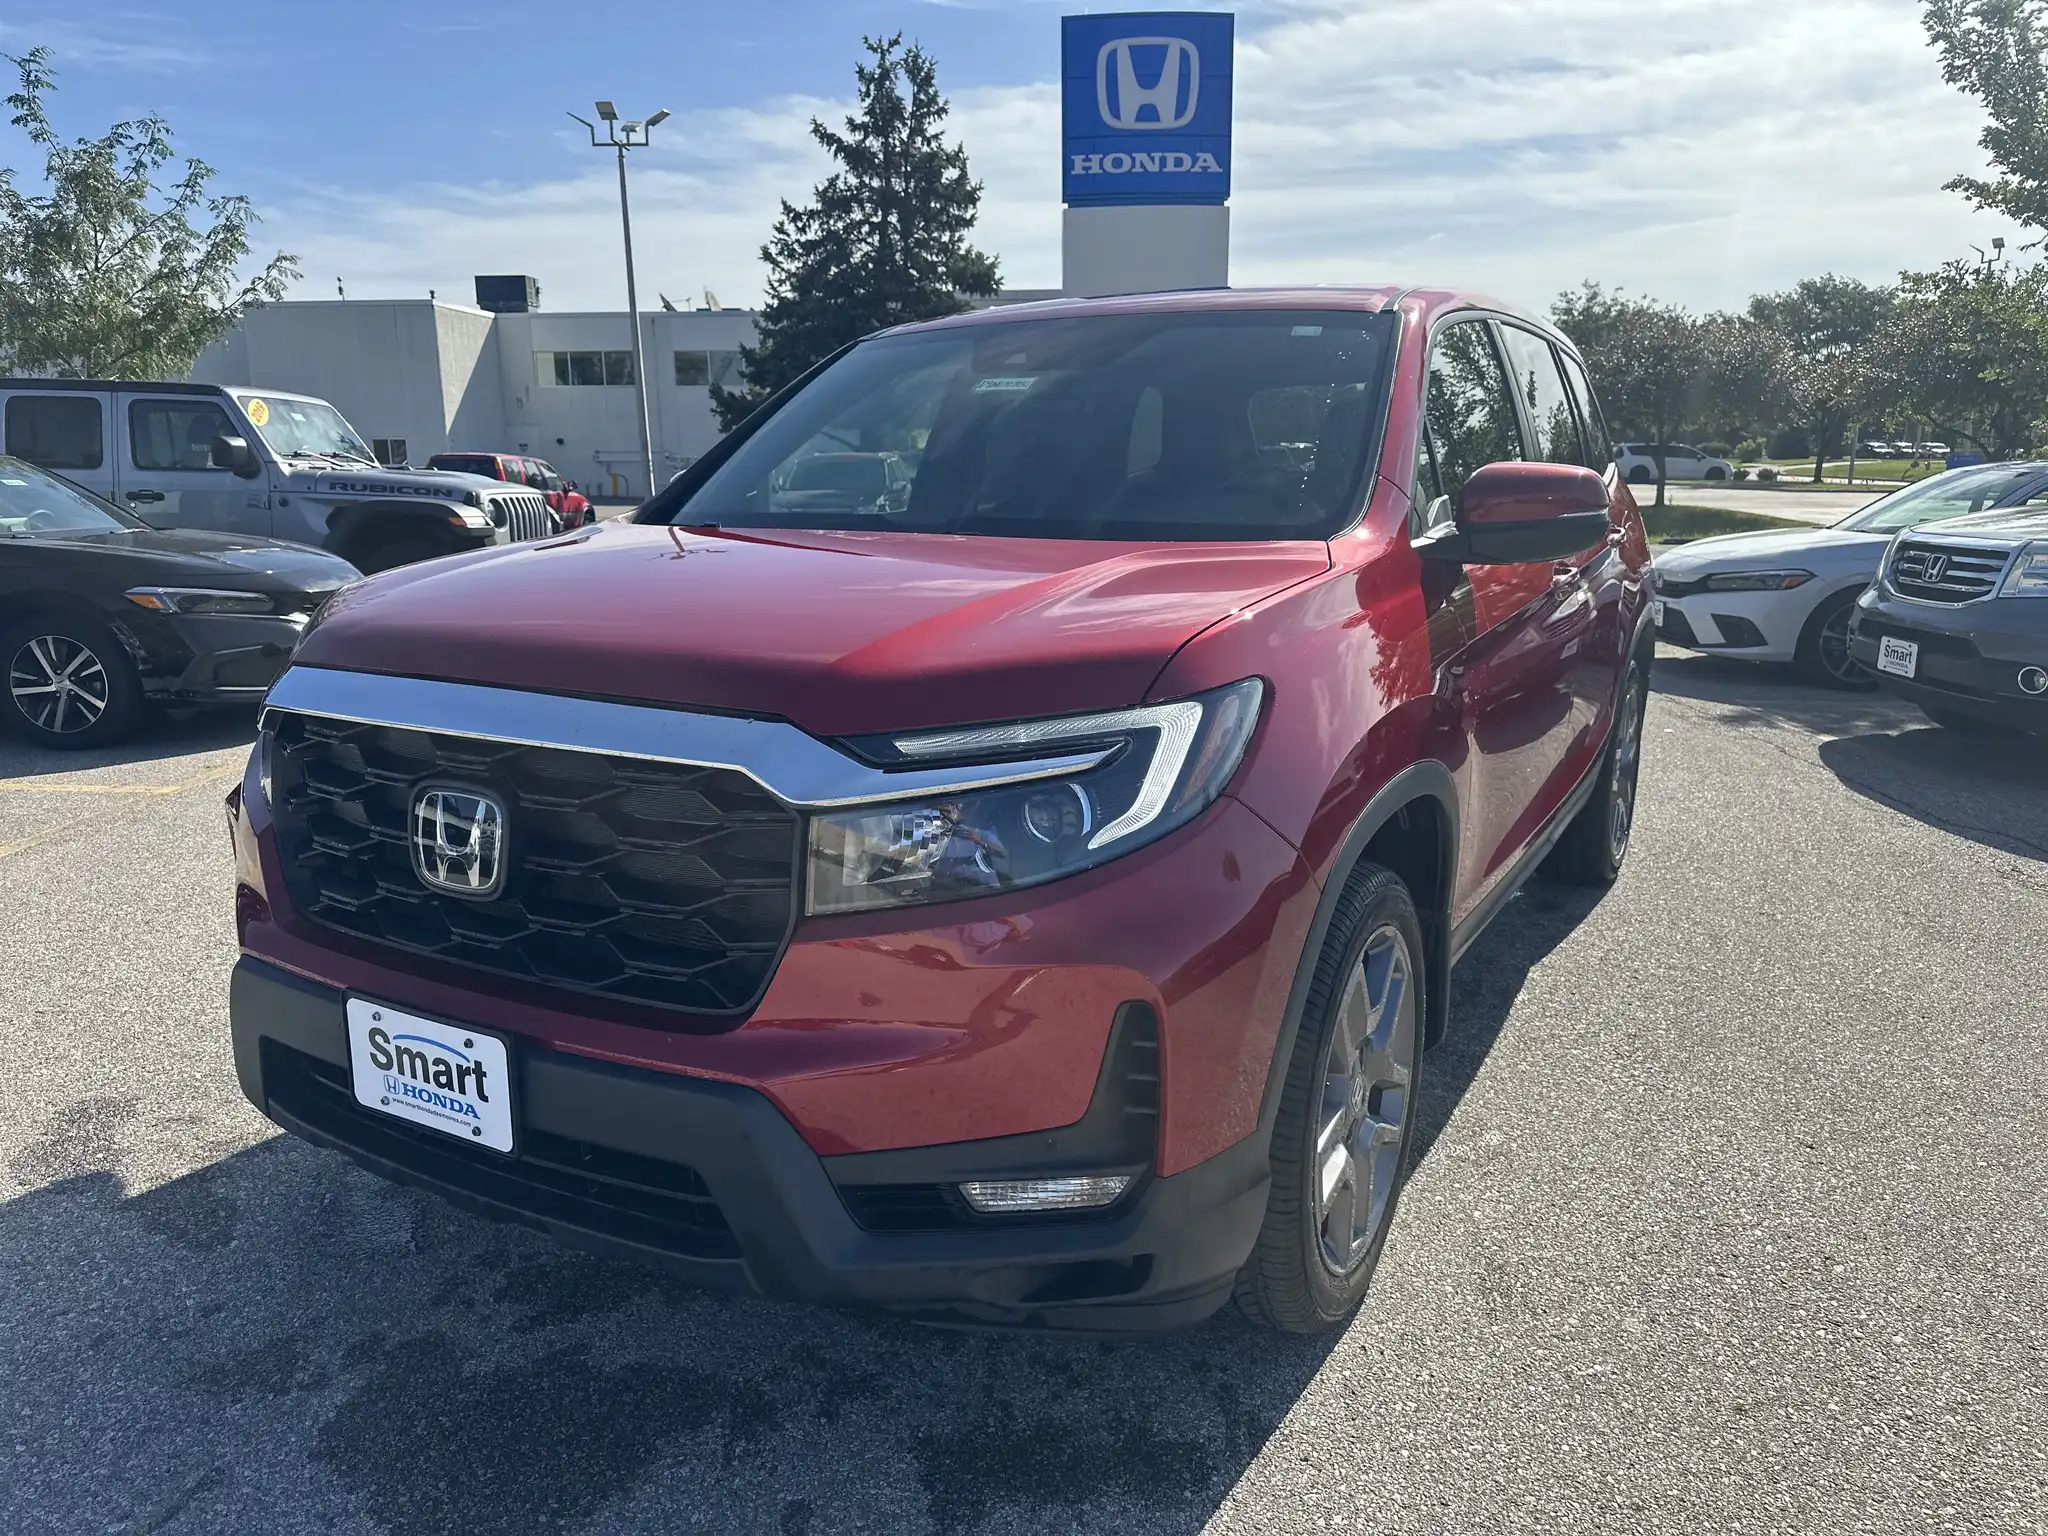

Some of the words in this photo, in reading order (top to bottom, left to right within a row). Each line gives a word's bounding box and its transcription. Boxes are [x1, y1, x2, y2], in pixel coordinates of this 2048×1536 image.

[1070, 152, 1223, 175] HONDA
[251, 401, 265, 424] 2019
[329, 482, 453, 497] RUBICON
[1884, 644, 1912, 664] Smart
[368, 1027, 489, 1103] Smart
[392, 1098, 472, 1127] www.smarthondadesmoines.com
[401, 1082, 481, 1120] HONDA
